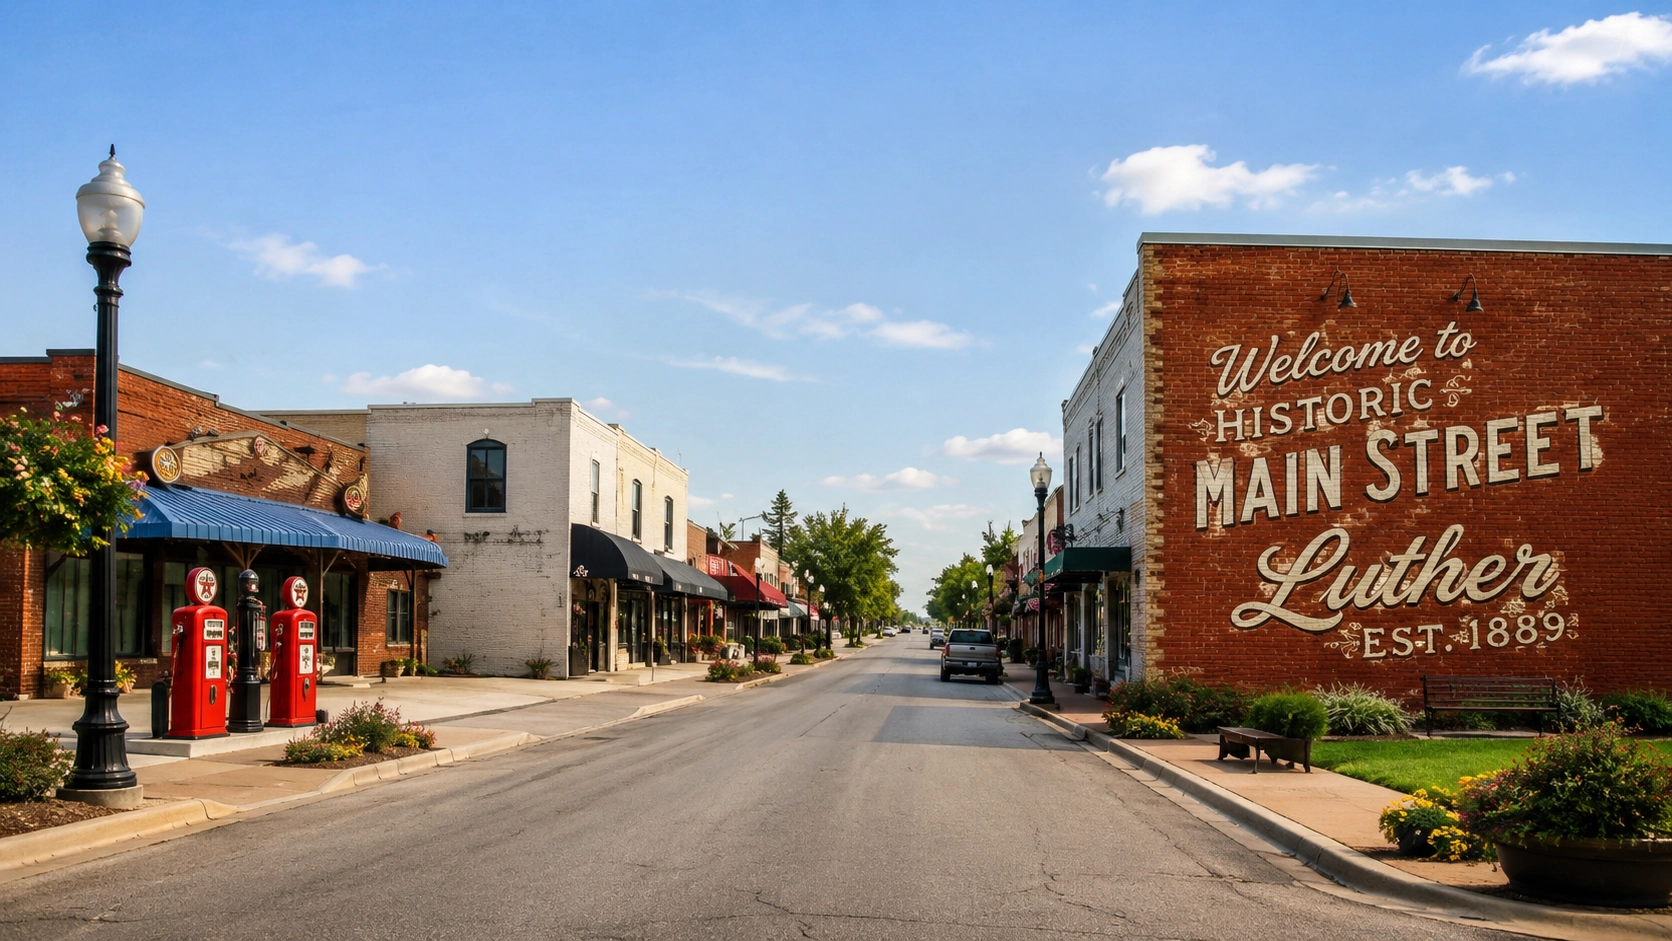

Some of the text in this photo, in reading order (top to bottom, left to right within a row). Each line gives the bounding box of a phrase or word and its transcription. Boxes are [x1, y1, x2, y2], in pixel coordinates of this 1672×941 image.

[1210, 321, 1476, 398] Welcome to
[1214, 379, 1434, 443] HISTORIC
[1195, 405, 1604, 530] MAIN STREET
[1230, 524, 1559, 632] Luther
[1362, 612, 1566, 659] EST. 1889
